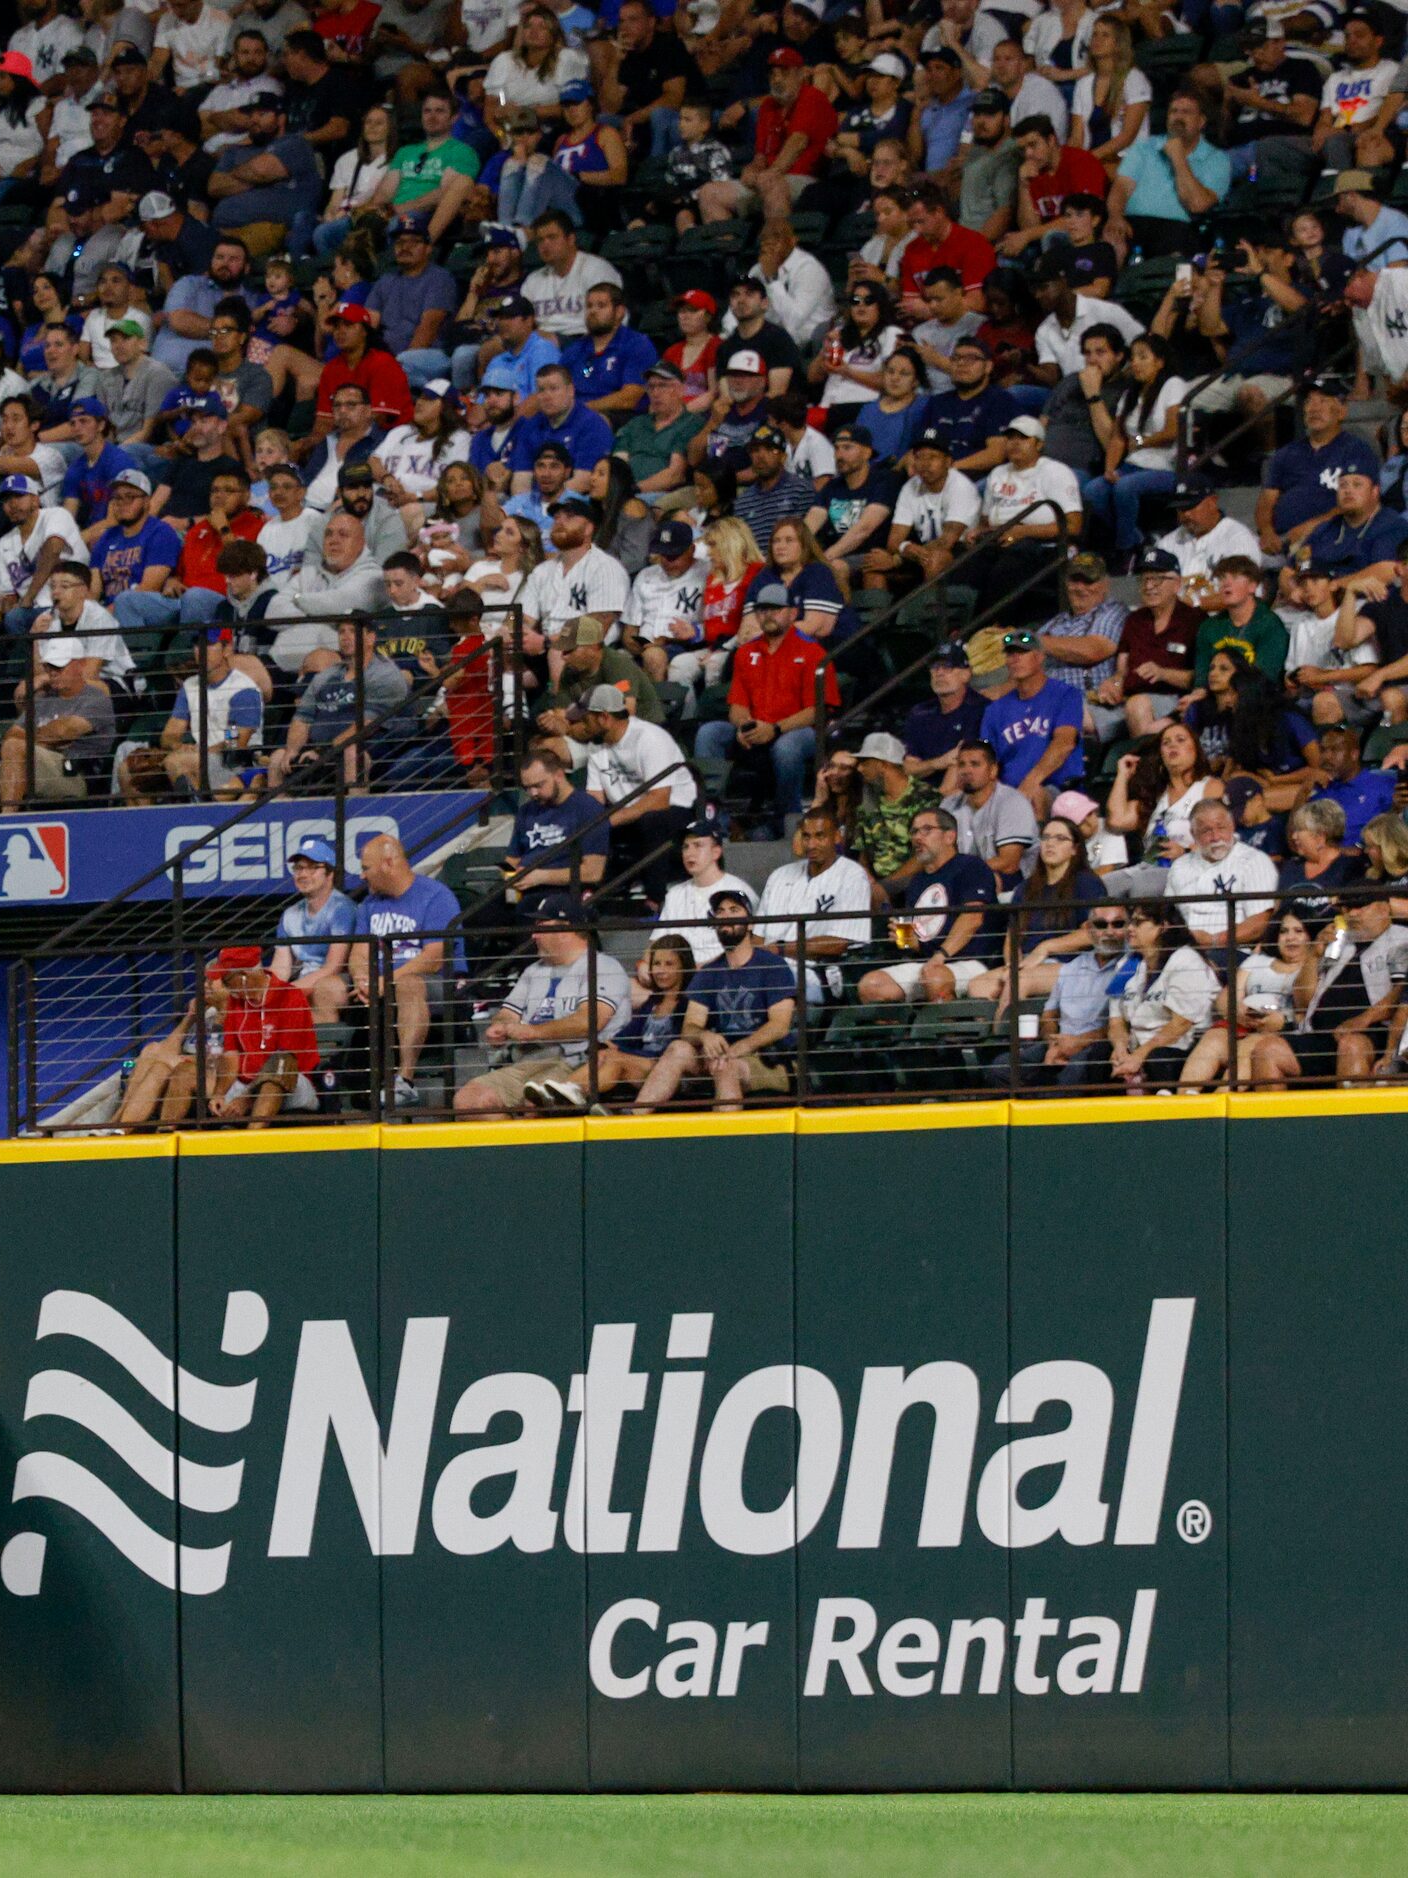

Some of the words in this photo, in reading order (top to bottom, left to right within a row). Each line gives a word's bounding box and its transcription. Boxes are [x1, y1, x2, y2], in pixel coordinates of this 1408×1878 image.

[1002, 716, 1051, 745] TEXAS
[268, 1298, 1196, 1559] National
[590, 1598, 770, 1700] Car
[804, 1589, 1158, 1698] Rental
